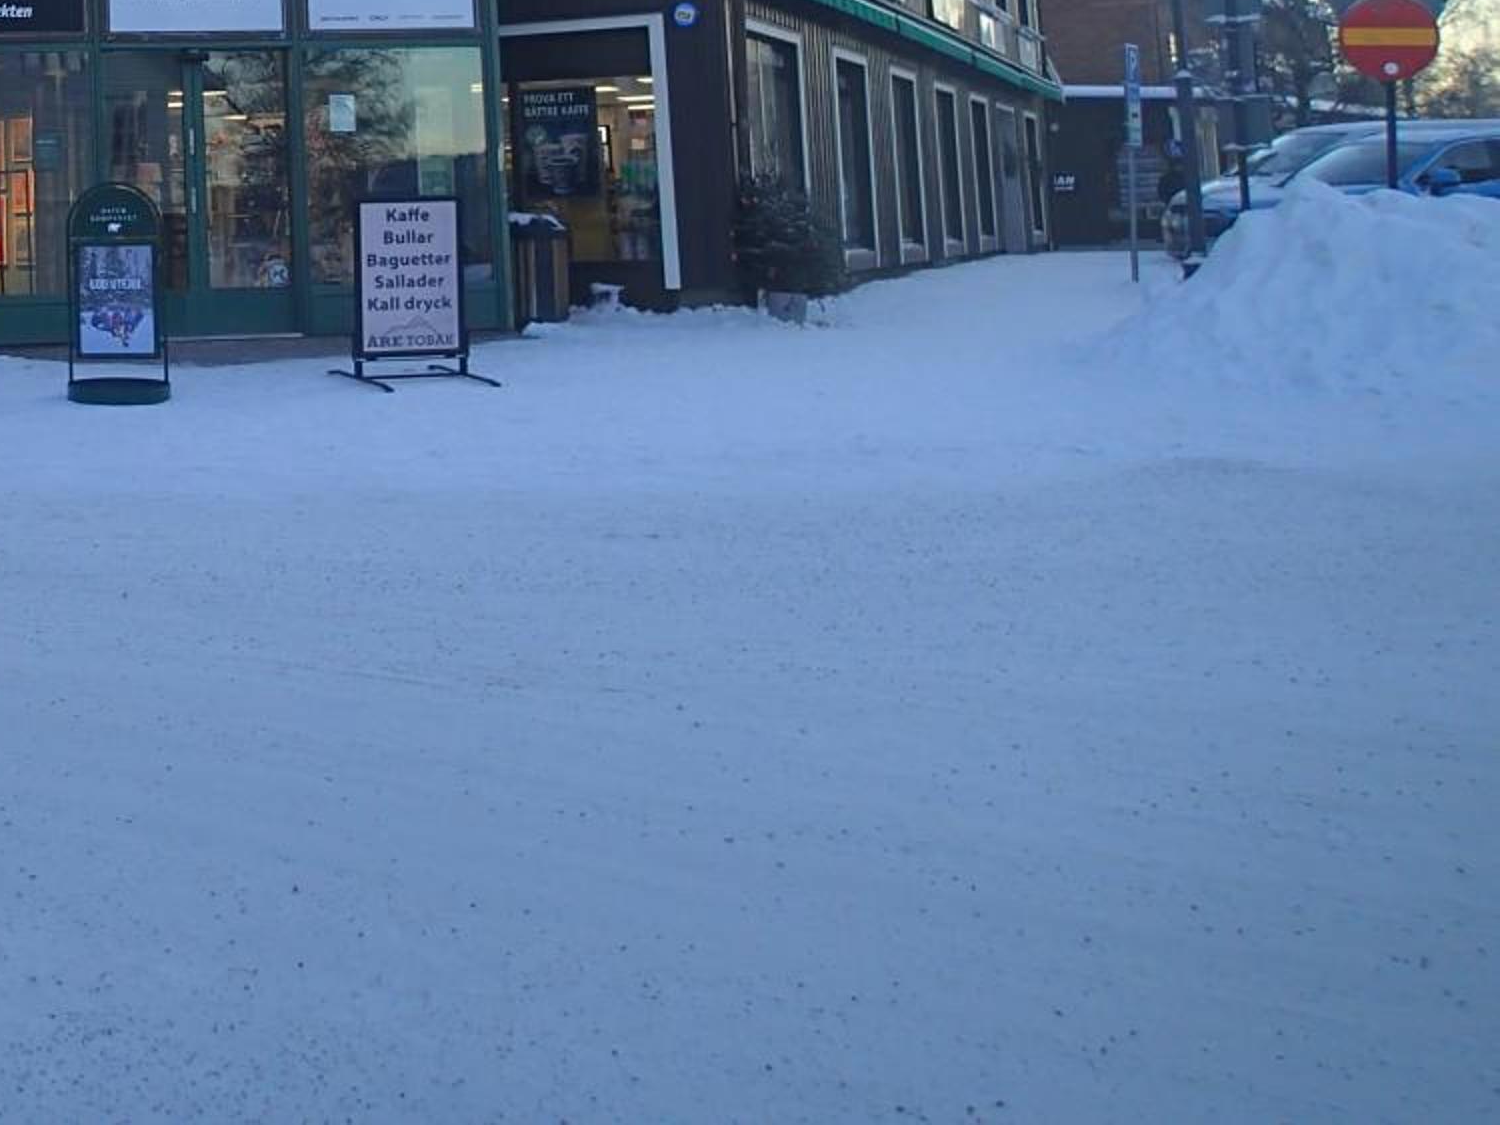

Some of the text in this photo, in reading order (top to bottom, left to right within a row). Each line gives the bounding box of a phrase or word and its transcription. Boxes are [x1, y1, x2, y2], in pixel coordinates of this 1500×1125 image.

[386, 208, 430, 223] Kaffe
[383, 229, 434, 245] Bullar
[367, 253, 451, 270] Baguetter
[375, 274, 445, 289] Sallader
[367, 296, 452, 313] Kall dryck
